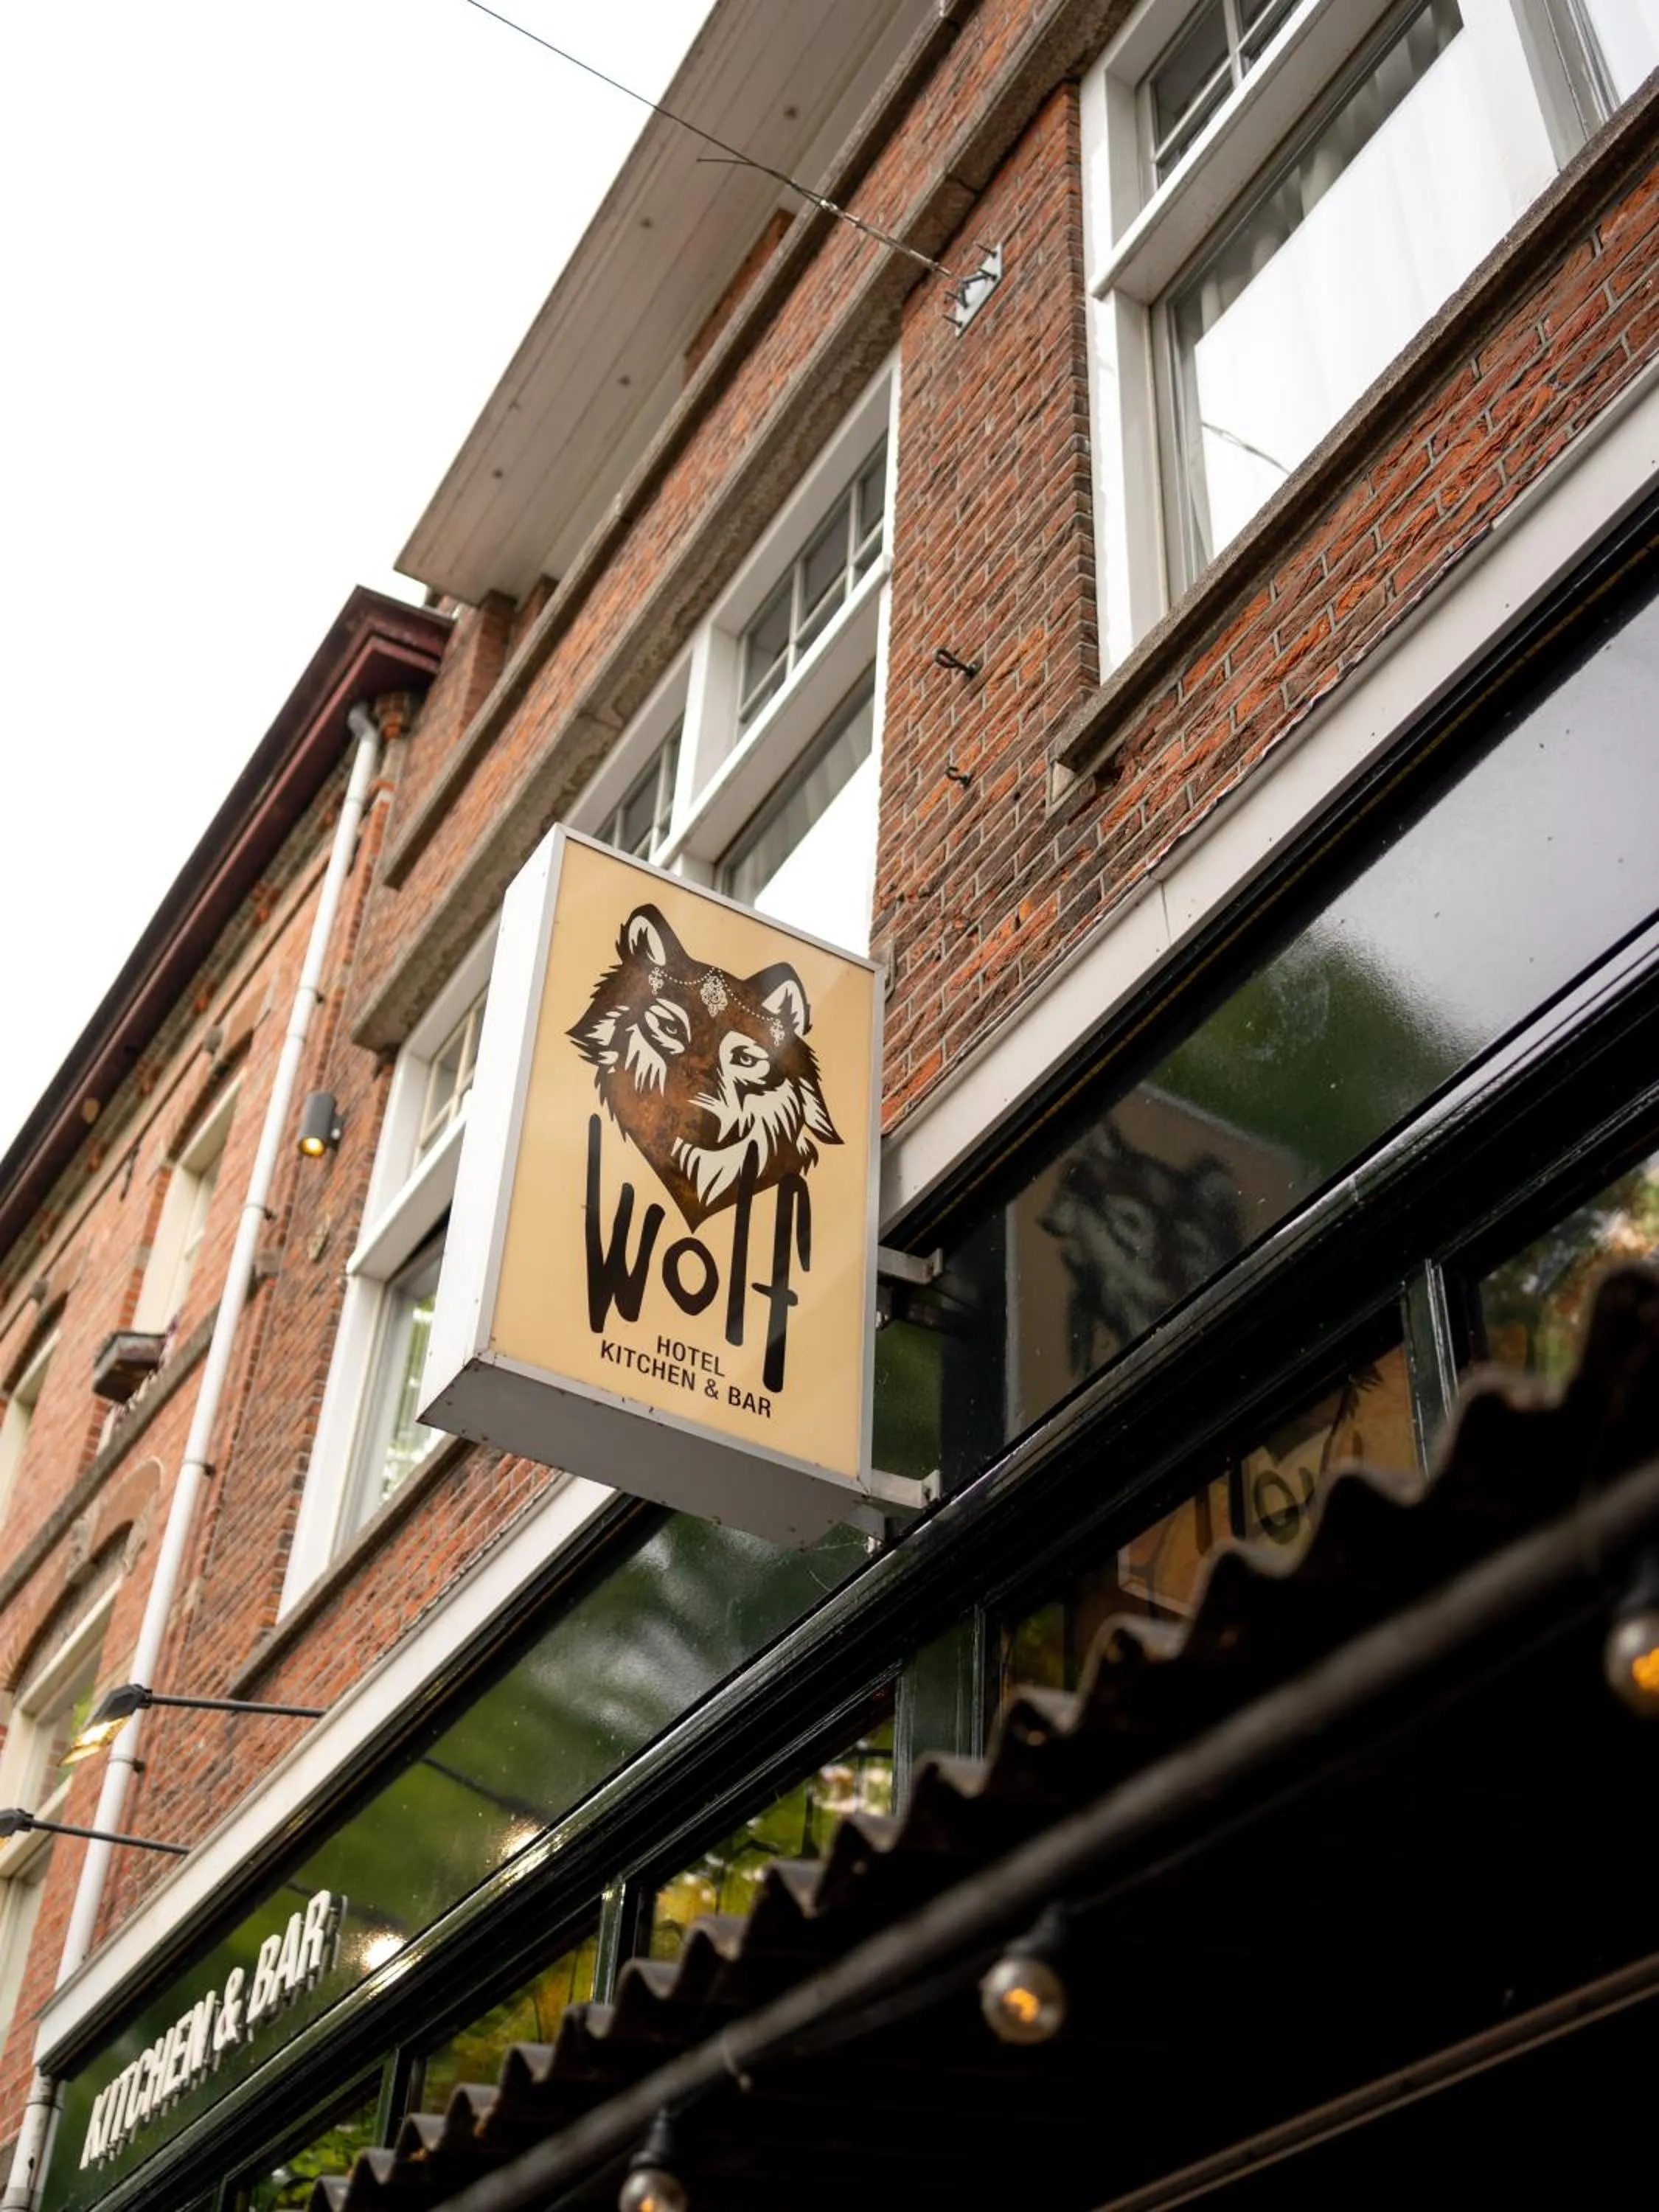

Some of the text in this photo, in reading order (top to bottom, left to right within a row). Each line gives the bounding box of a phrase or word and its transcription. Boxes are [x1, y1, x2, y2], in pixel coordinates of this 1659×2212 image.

[585, 1113, 811, 1393] Wolf
[600, 1340, 772, 1419] KITCHEN & BAR
[656, 1335, 726, 1377] HOTEL
[79, 1889, 331, 2170] KITCHEN & BAR
